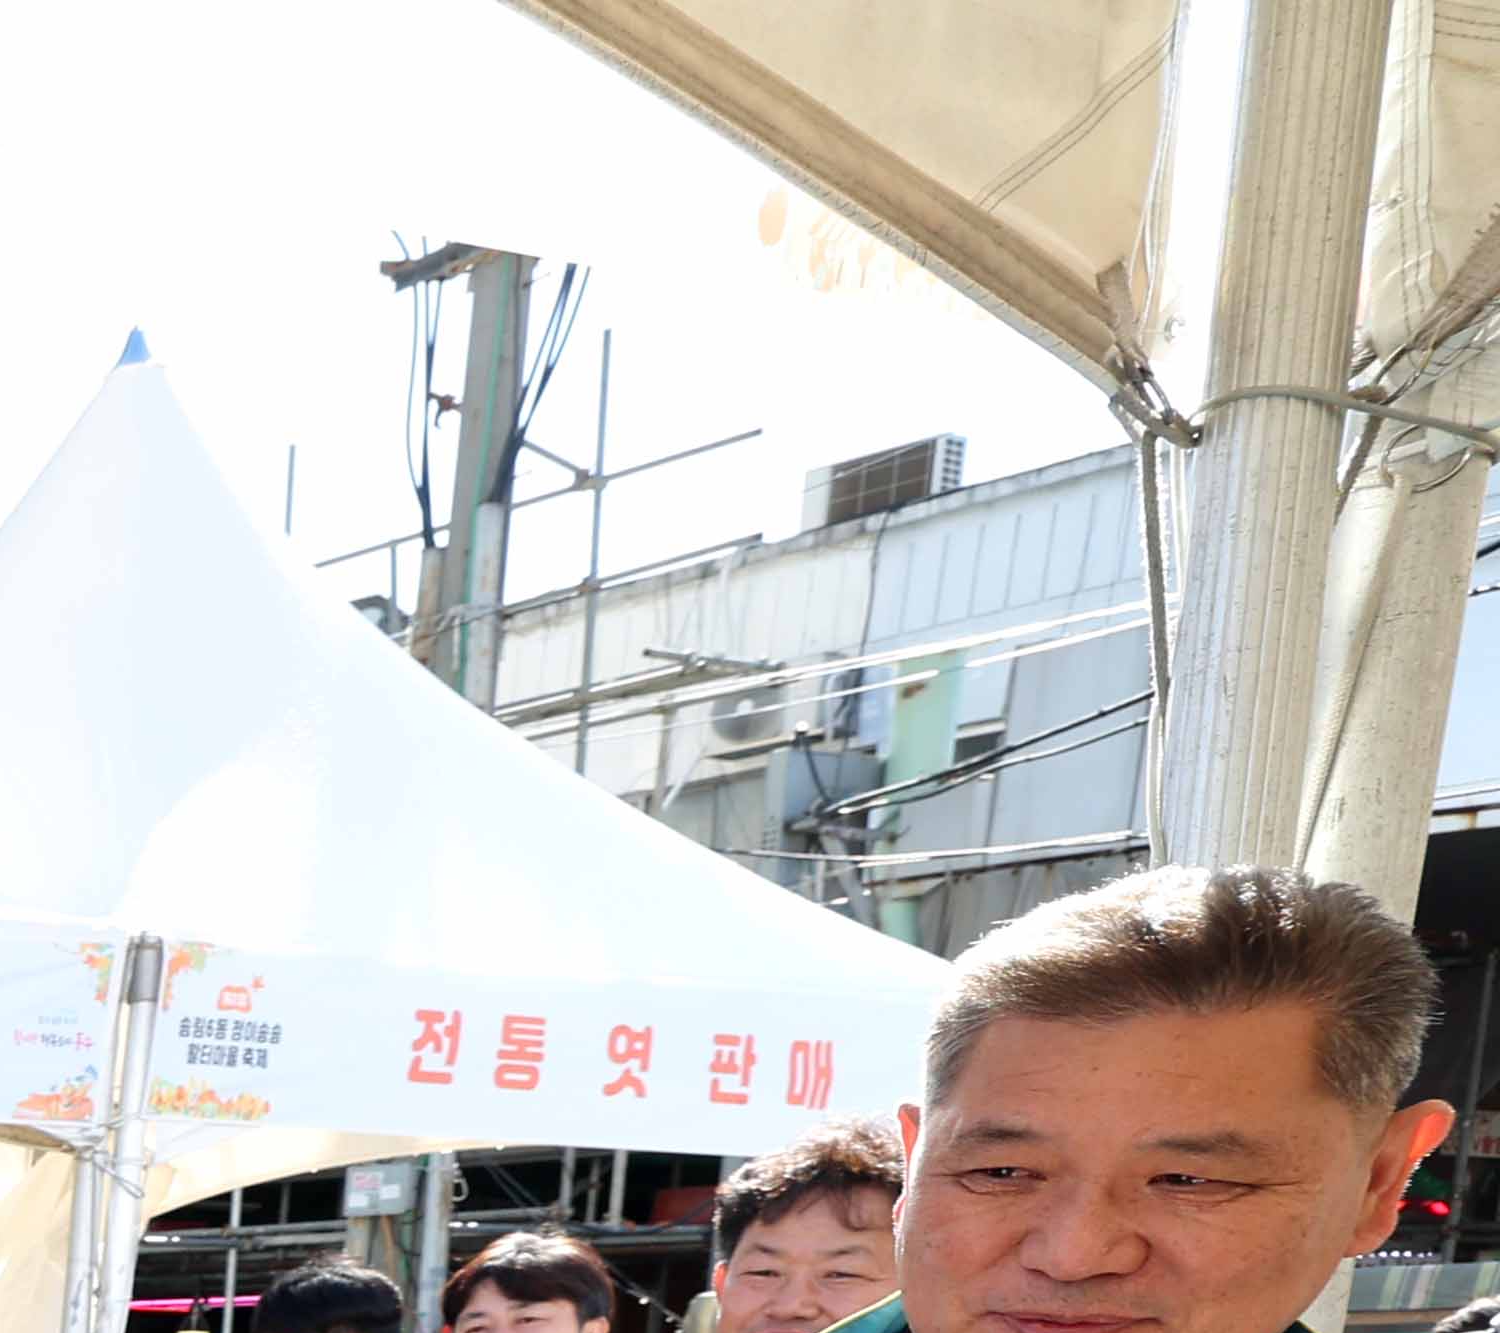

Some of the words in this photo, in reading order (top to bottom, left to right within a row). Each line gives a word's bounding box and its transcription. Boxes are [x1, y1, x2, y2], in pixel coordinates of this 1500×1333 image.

[408, 1009, 545, 1091] 전통
[602, 1022, 653, 1099] 엿
[708, 1034, 836, 1110] 판매
